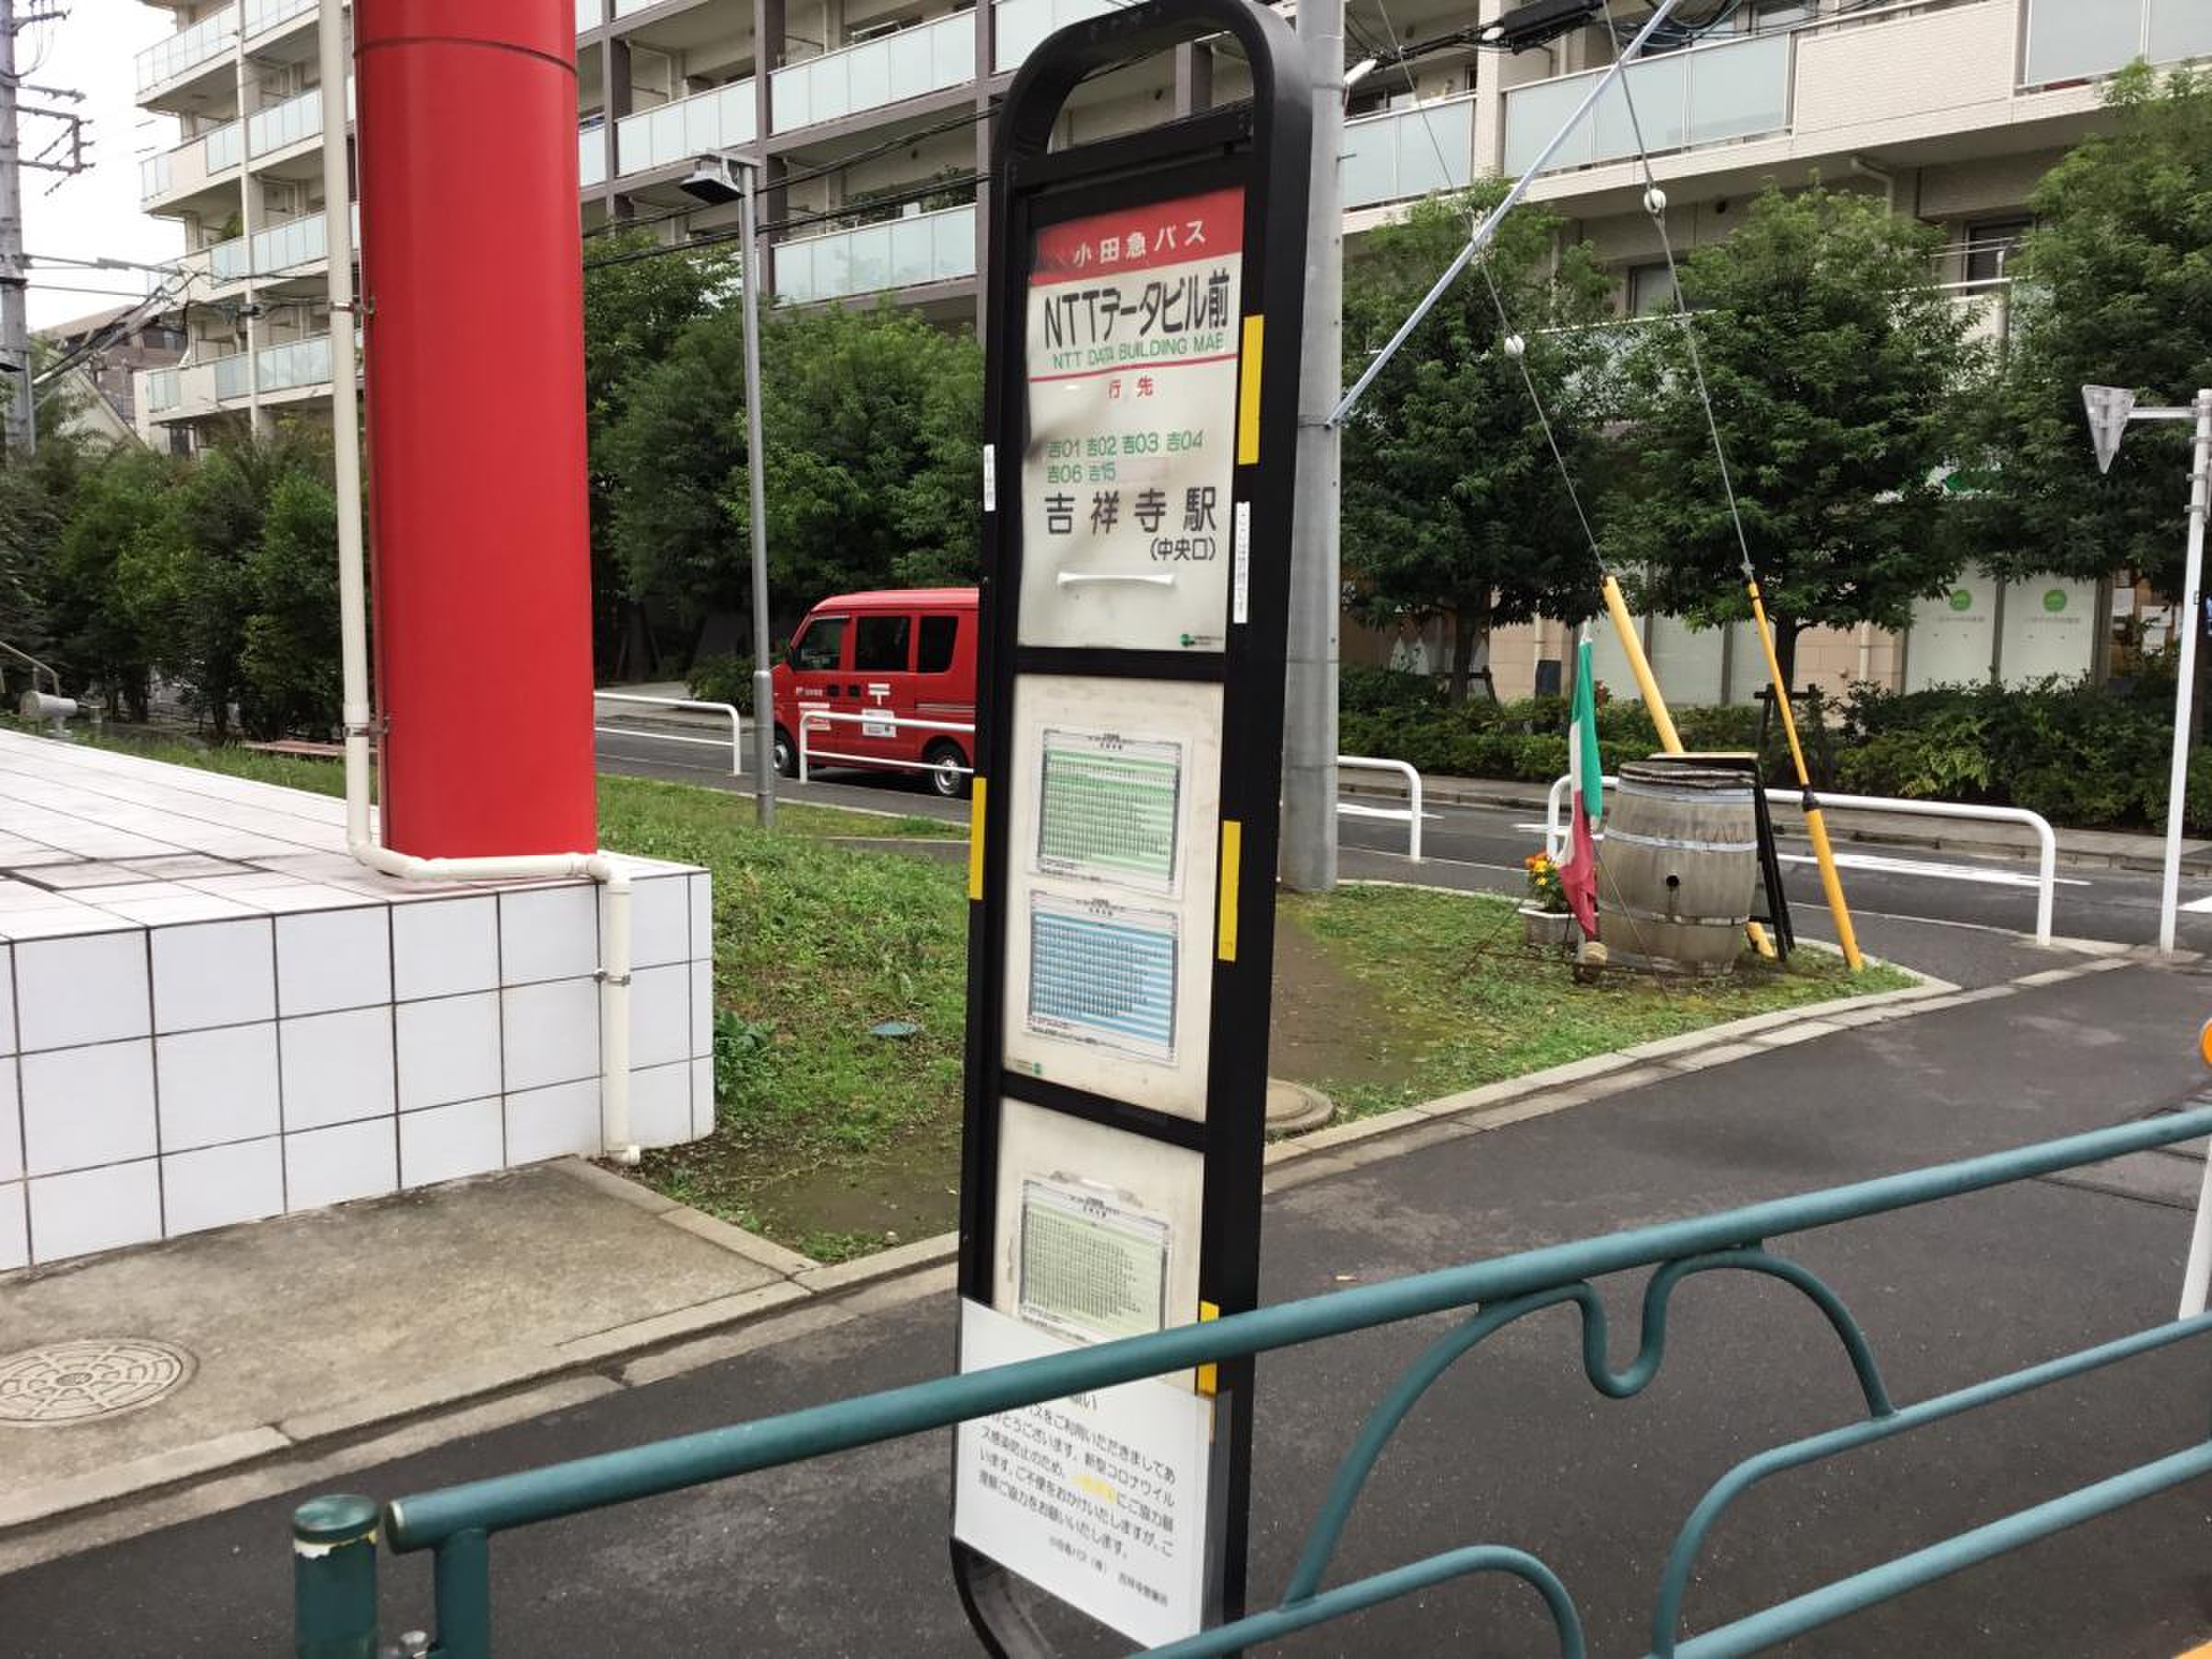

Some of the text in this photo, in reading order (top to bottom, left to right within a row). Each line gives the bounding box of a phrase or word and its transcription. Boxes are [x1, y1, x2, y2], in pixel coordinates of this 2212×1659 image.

[1074, 220, 1206, 267] 小田急バス
[1044, 268, 1230, 350] NTTデータビル前
[1053, 332, 1224, 370] NTT DATA BUILDING MAE
[1109, 375, 1154, 399] 行先
[1047, 429, 1205, 458] 吉01 吉02 吉03 吉04
[1047, 462, 1117, 484] 吉06 吉15
[1044, 487, 1217, 535] 吉祥寺駅
